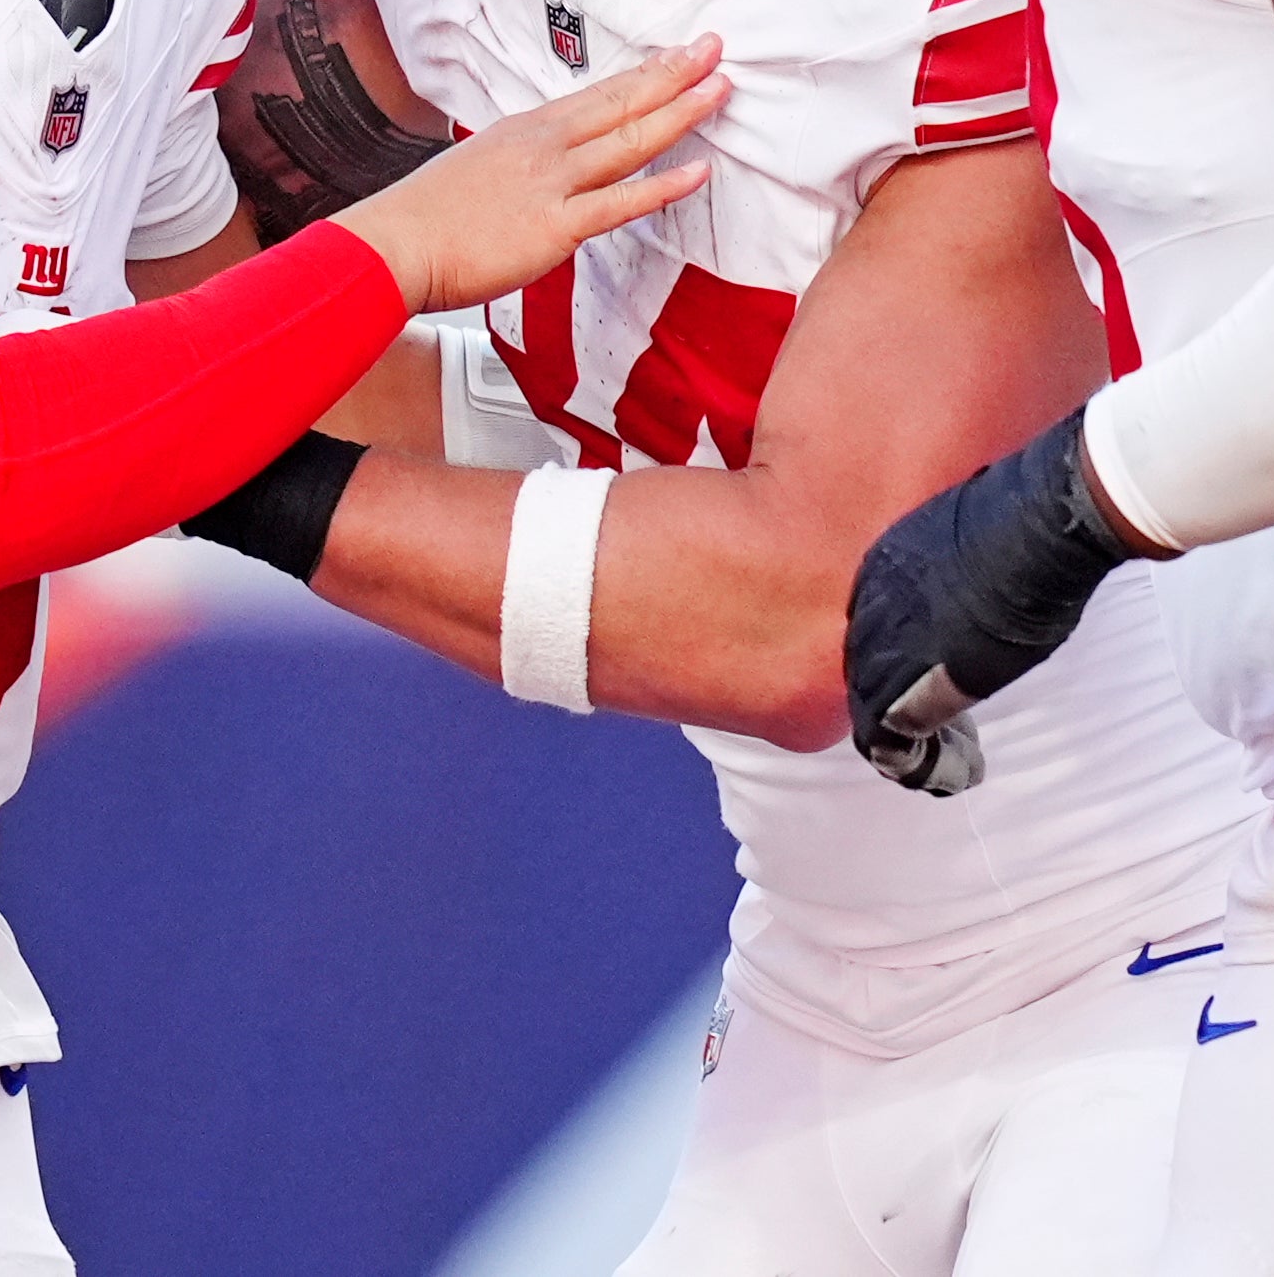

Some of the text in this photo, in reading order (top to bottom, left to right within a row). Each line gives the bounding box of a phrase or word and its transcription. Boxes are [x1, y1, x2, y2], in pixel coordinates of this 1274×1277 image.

[553, 28, 583, 63] NFL
[47, 113, 79, 148] NFL
[16, 242, 70, 297] ny
